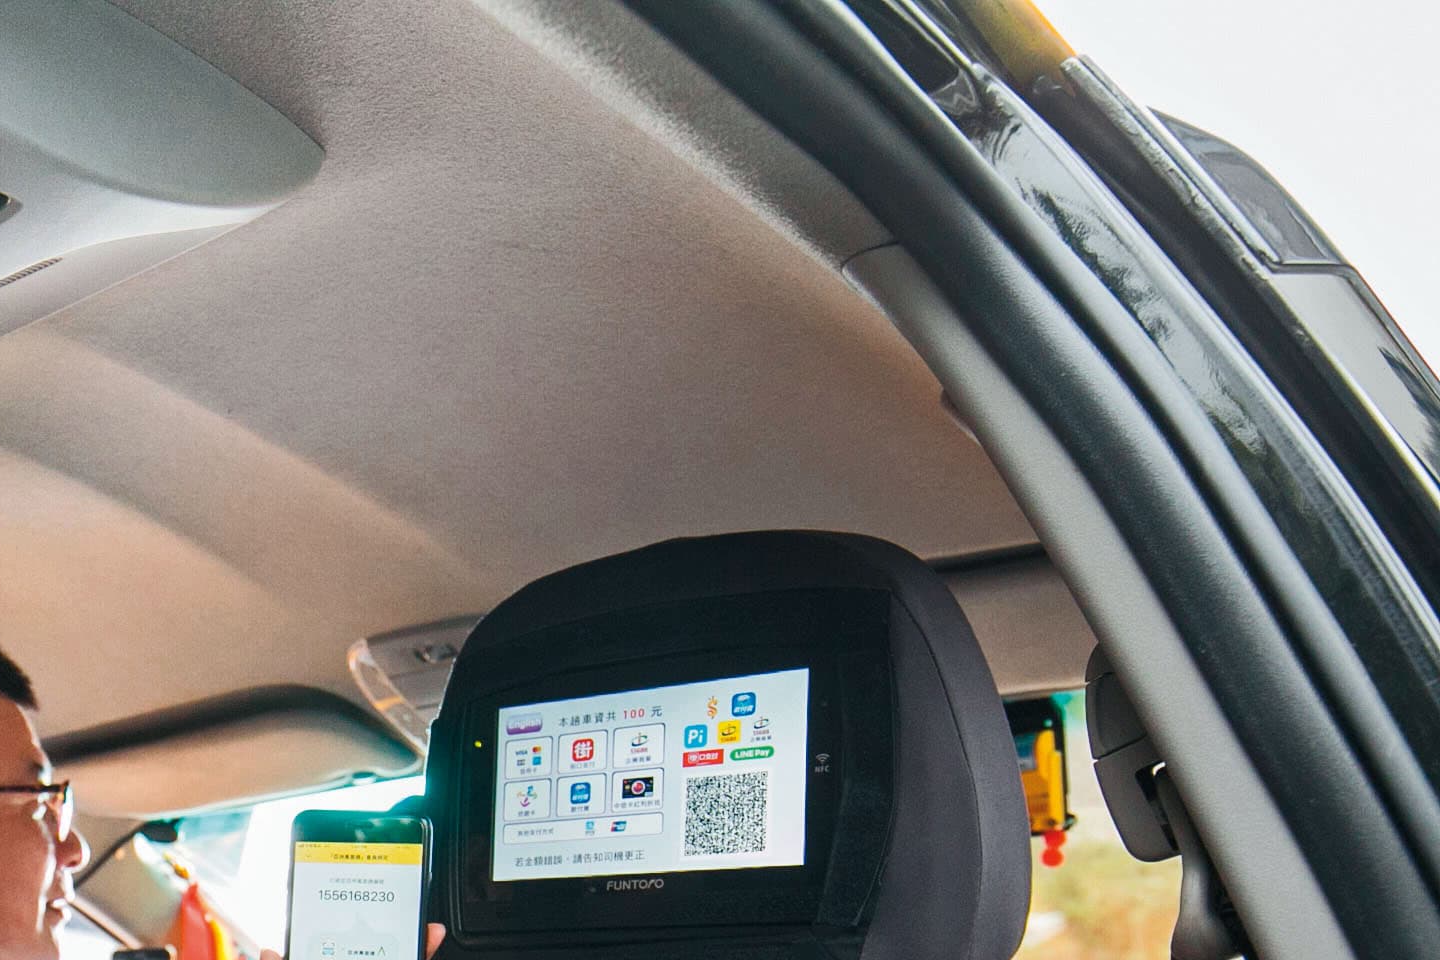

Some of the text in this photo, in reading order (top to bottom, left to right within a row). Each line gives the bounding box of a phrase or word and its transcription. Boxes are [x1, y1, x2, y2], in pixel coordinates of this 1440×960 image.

[558, 706, 662, 727] 本趟車資共 100 元
[688, 729, 703, 744] Pi
[735, 748, 770, 759] LINE Pay
[319, 889, 395, 902] 1556168230
